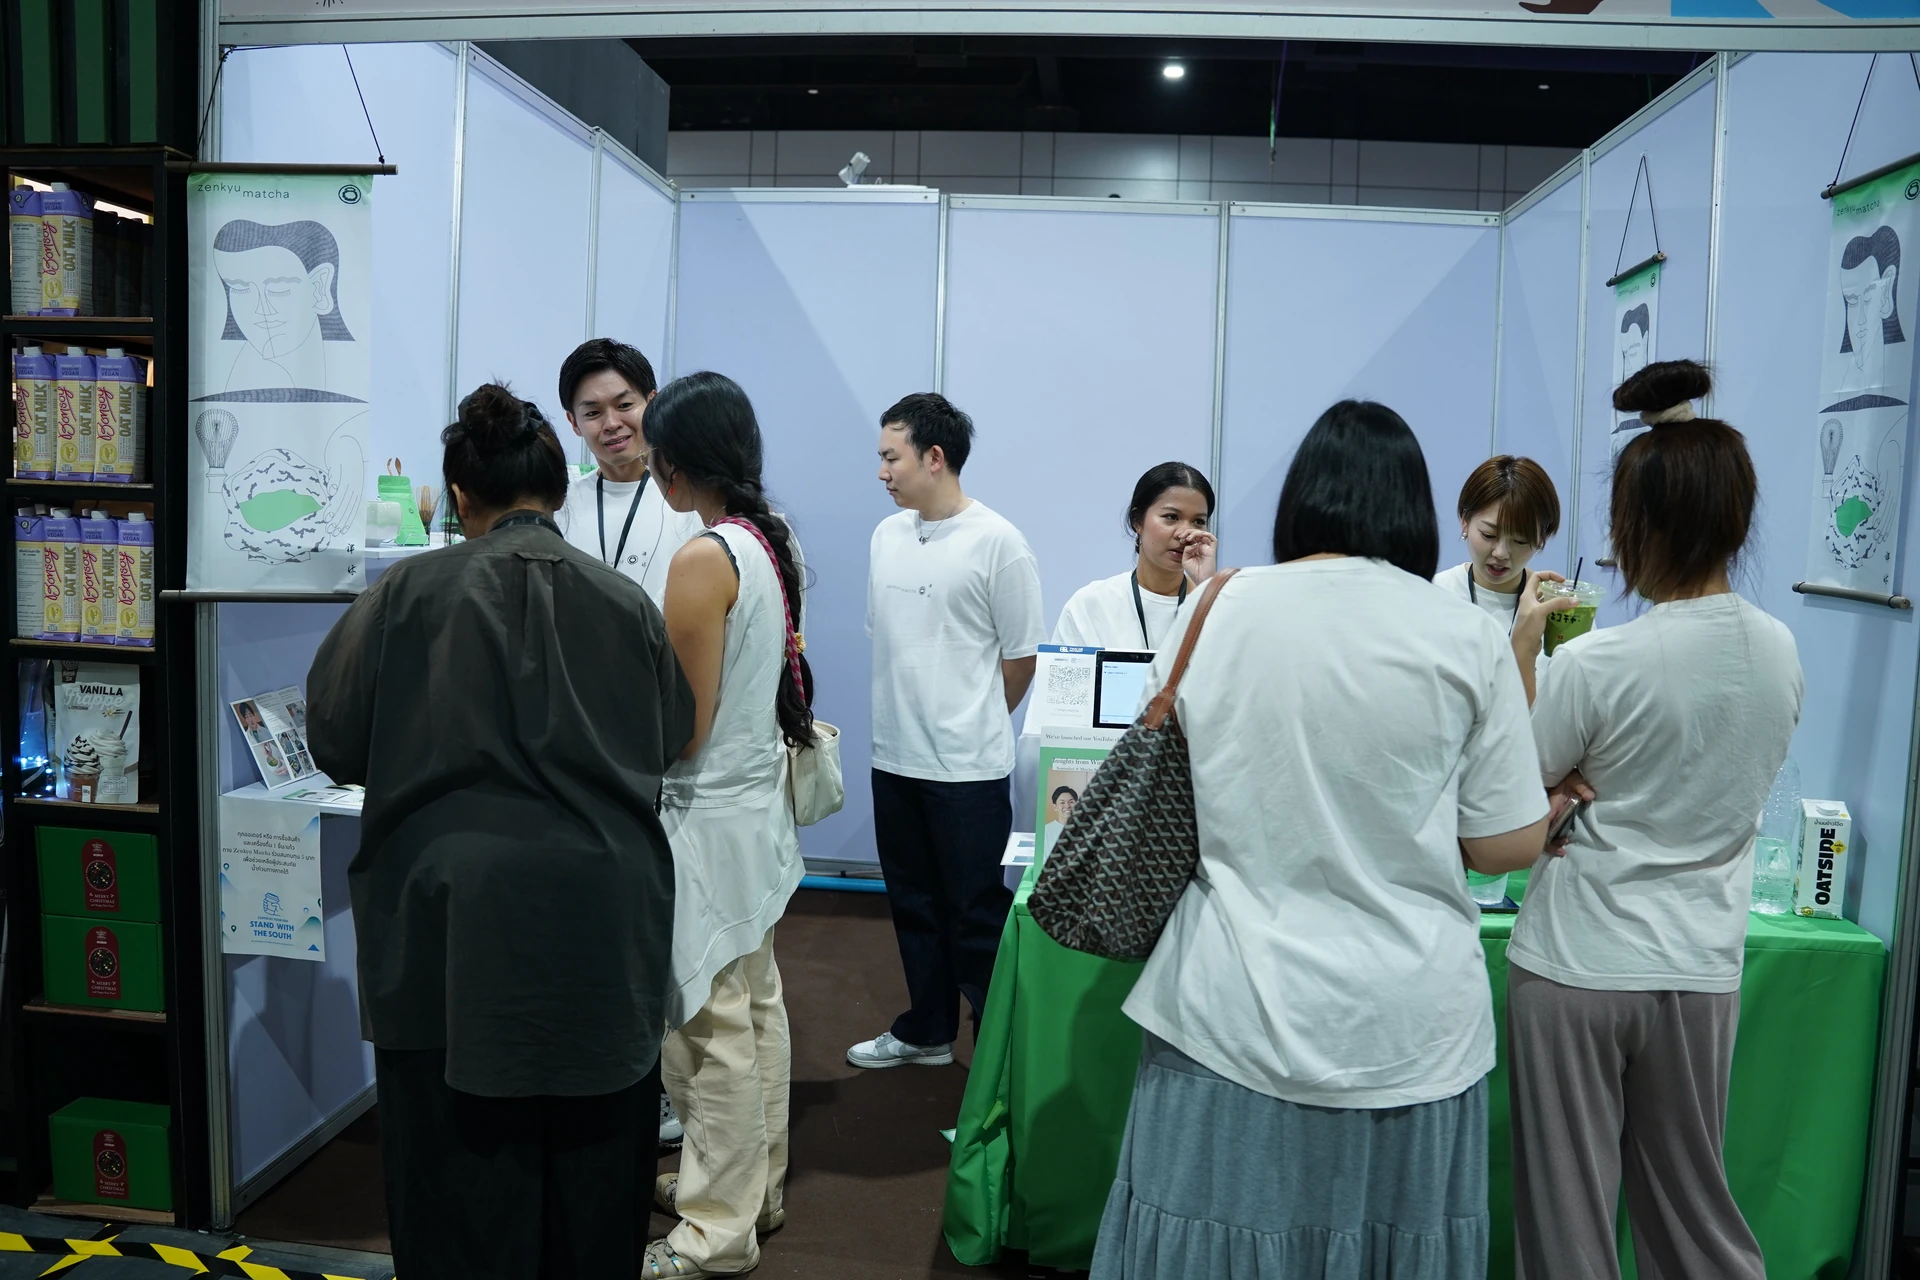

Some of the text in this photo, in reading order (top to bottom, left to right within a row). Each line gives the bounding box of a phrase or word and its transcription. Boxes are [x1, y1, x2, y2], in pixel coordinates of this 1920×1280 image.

[197, 182, 290, 199] zenkyu matcha
[1856, 200, 1880, 215] matcha
[63, 220, 76, 248] MILK
[63, 250, 76, 271] OAT
[35, 383, 48, 412] MILK
[80, 385, 92, 413] MILK
[119, 385, 132, 415] MILK
[35, 415, 48, 435] OAT
[80, 416, 92, 436] OAT
[119, 417, 132, 437] OAT
[64, 546, 76, 574] MILK
[102, 548, 115, 577] MILK
[140, 550, 152, 579] MILK
[64, 578, 76, 597] OAT
[102, 580, 115, 599] OAT
[140, 582, 152, 601] OAT
[80, 684, 123, 696] VANILLA
[1815, 828, 1836, 905] OATSIDE
[268, 931, 292, 940] SOUTH
